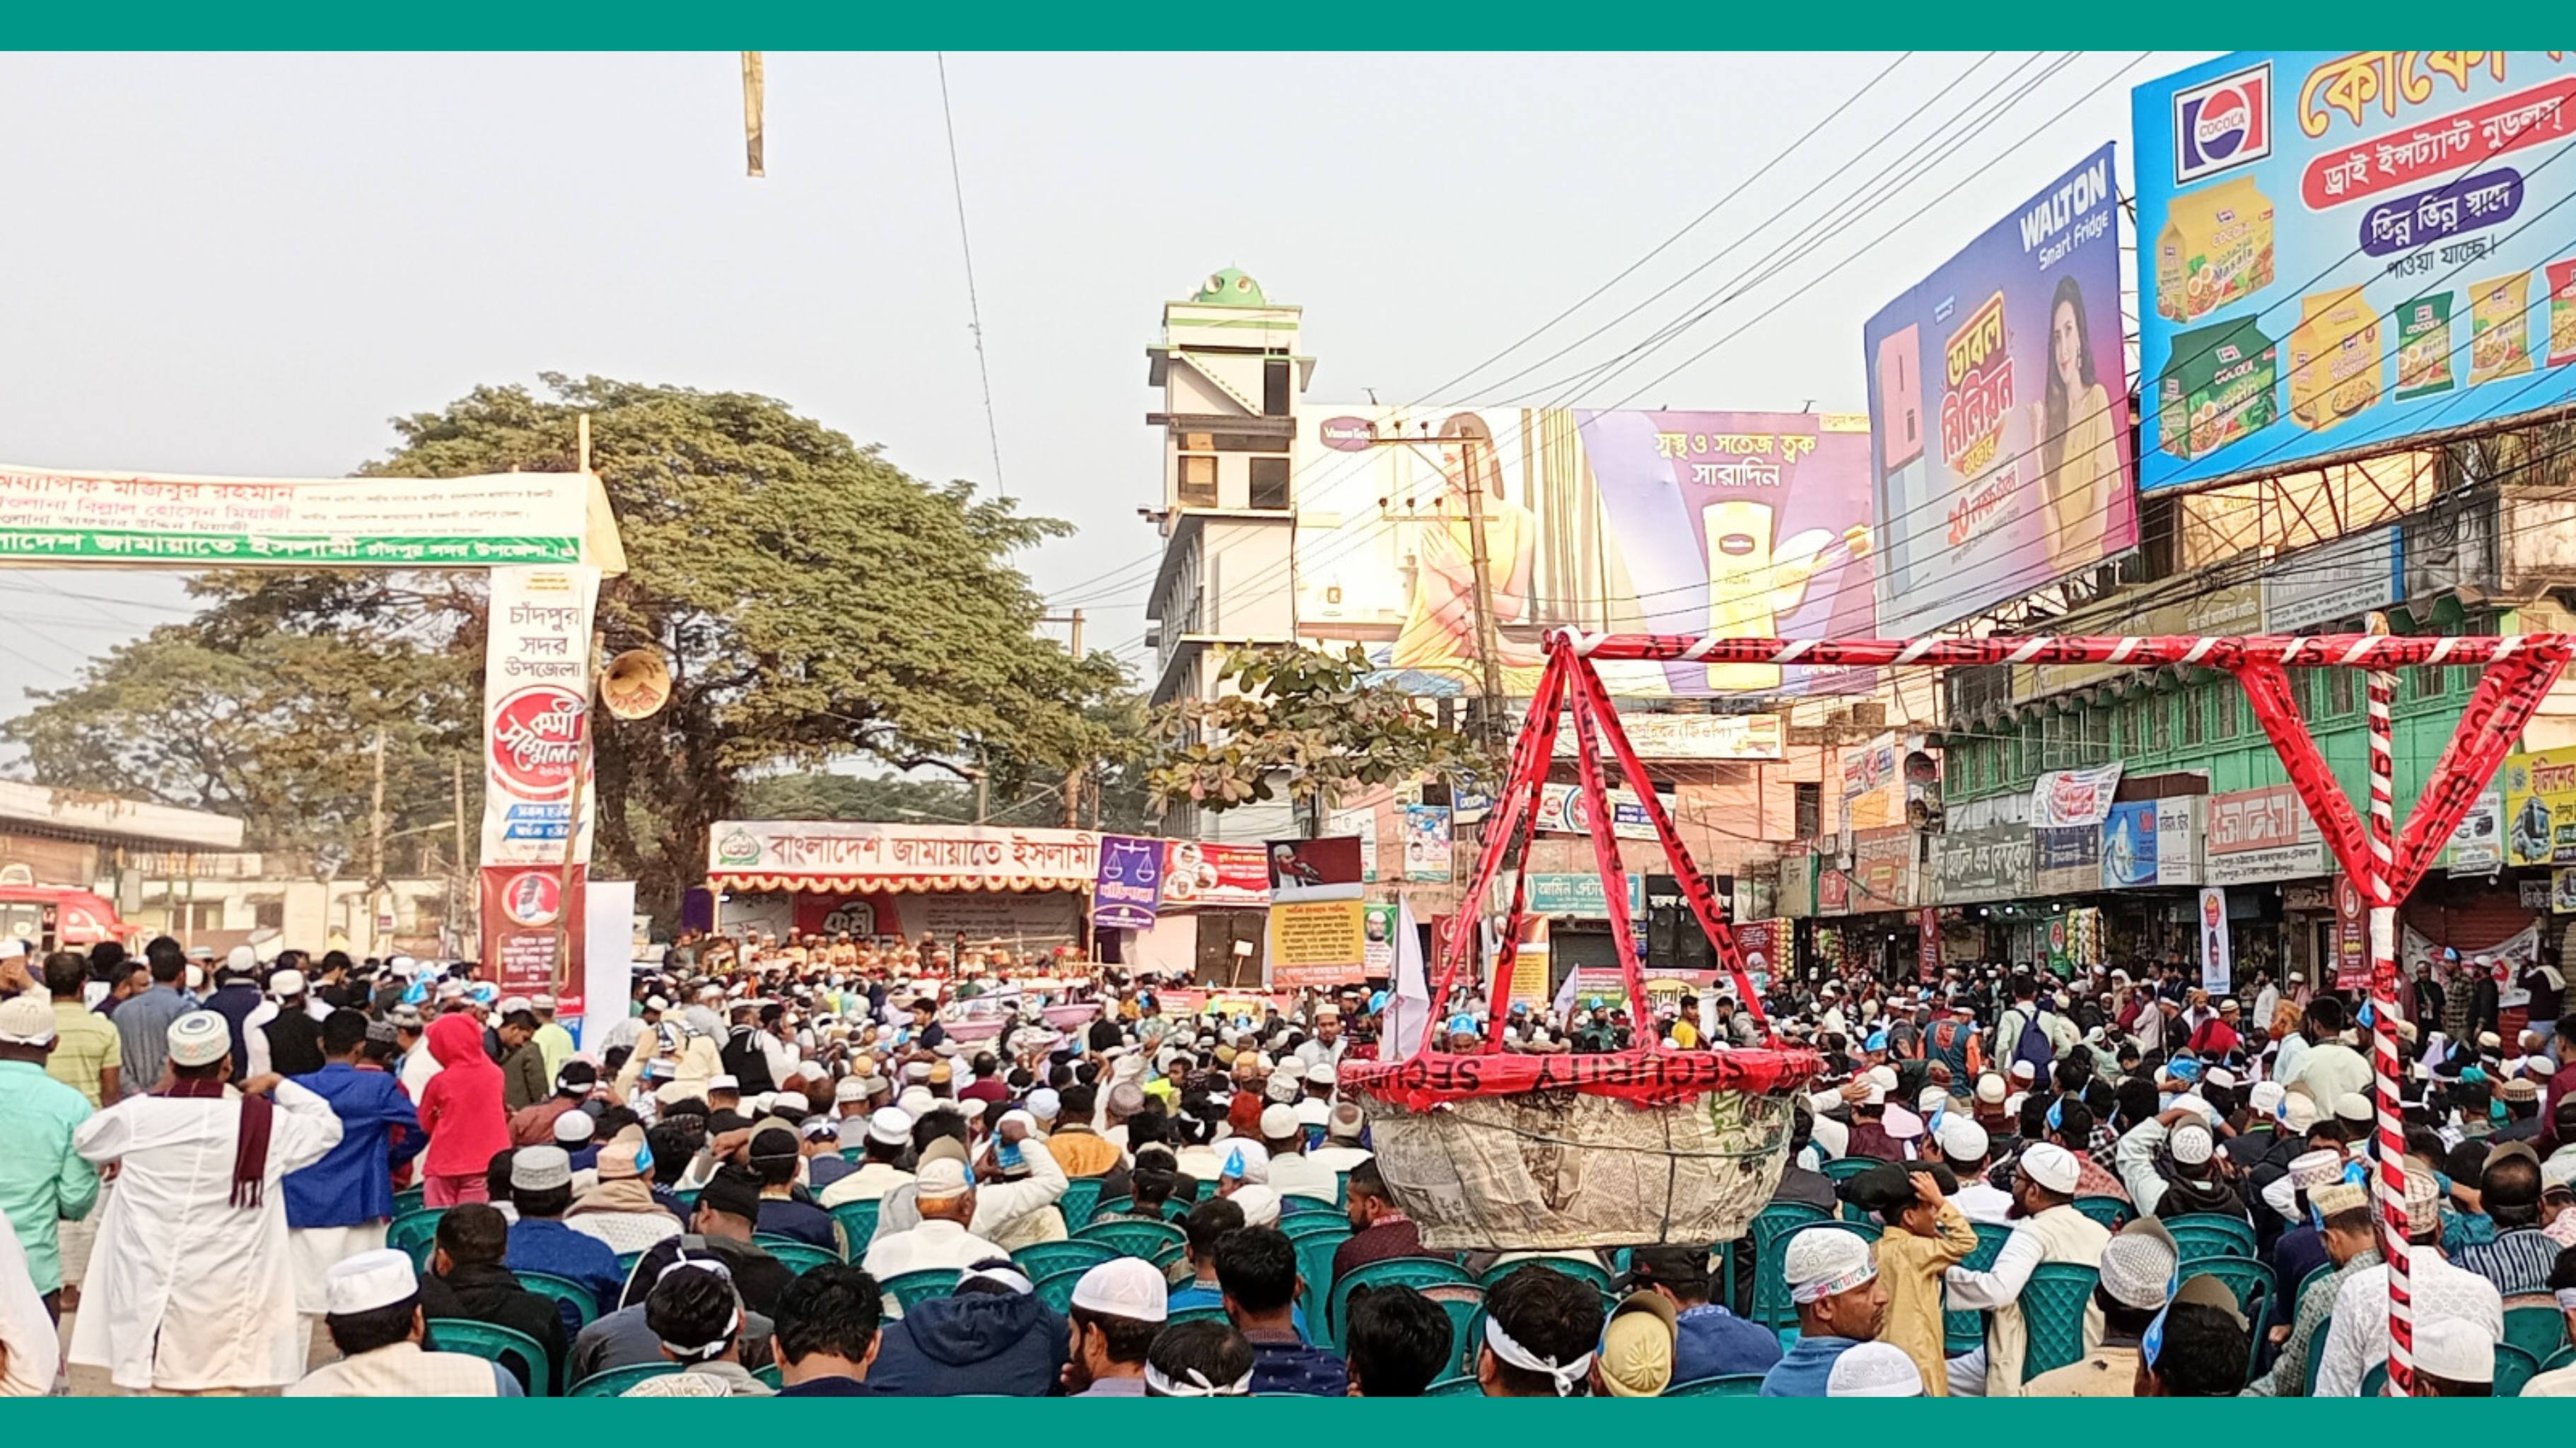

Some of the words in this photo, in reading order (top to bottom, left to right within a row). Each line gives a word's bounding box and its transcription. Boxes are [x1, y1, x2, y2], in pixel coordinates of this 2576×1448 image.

[2199, 110, 2246, 139] COCOLA
[2324, 153, 2370, 196] ড্রাই
[2020, 158, 2106, 253] WALTON
[2371, 207, 2411, 246] ভিন্ন
[2416, 194, 2459, 233] ভিন্ন
[2039, 232, 2072, 271] Smart
[2074, 210, 2109, 248] Fridge
[2387, 247, 2435, 282] পাওয়া
[1947, 303, 2002, 386] ডাবল
[1941, 361, 2015, 465] মিলিয়ন
[1655, 432, 1689, 460] সুস্থ
[1691, 434, 1708, 454] ও
[1713, 433, 1774, 456] সতেজ
[1780, 433, 1817, 462] ত্বক
[1691, 457, 1781, 486] সারাদিন
[213, 482, 297, 502] রহমান
[93, 534, 238, 556] জামায়াতে
[249, 534, 357, 558] ইসলামী
[509, 602, 581, 632] চাঁদপুর
[518, 636, 569, 655] সদর
[505, 656, 581, 677] উপজেলা
[768, 834, 884, 867] বাংলাদেশ
[891, 836, 1004, 869] জামায়াতে
[1013, 832, 1097, 872] ইসলামী
[1537, 877, 1571, 897] আমিন
[1530, 1056, 1746, 1091] SECURITY
